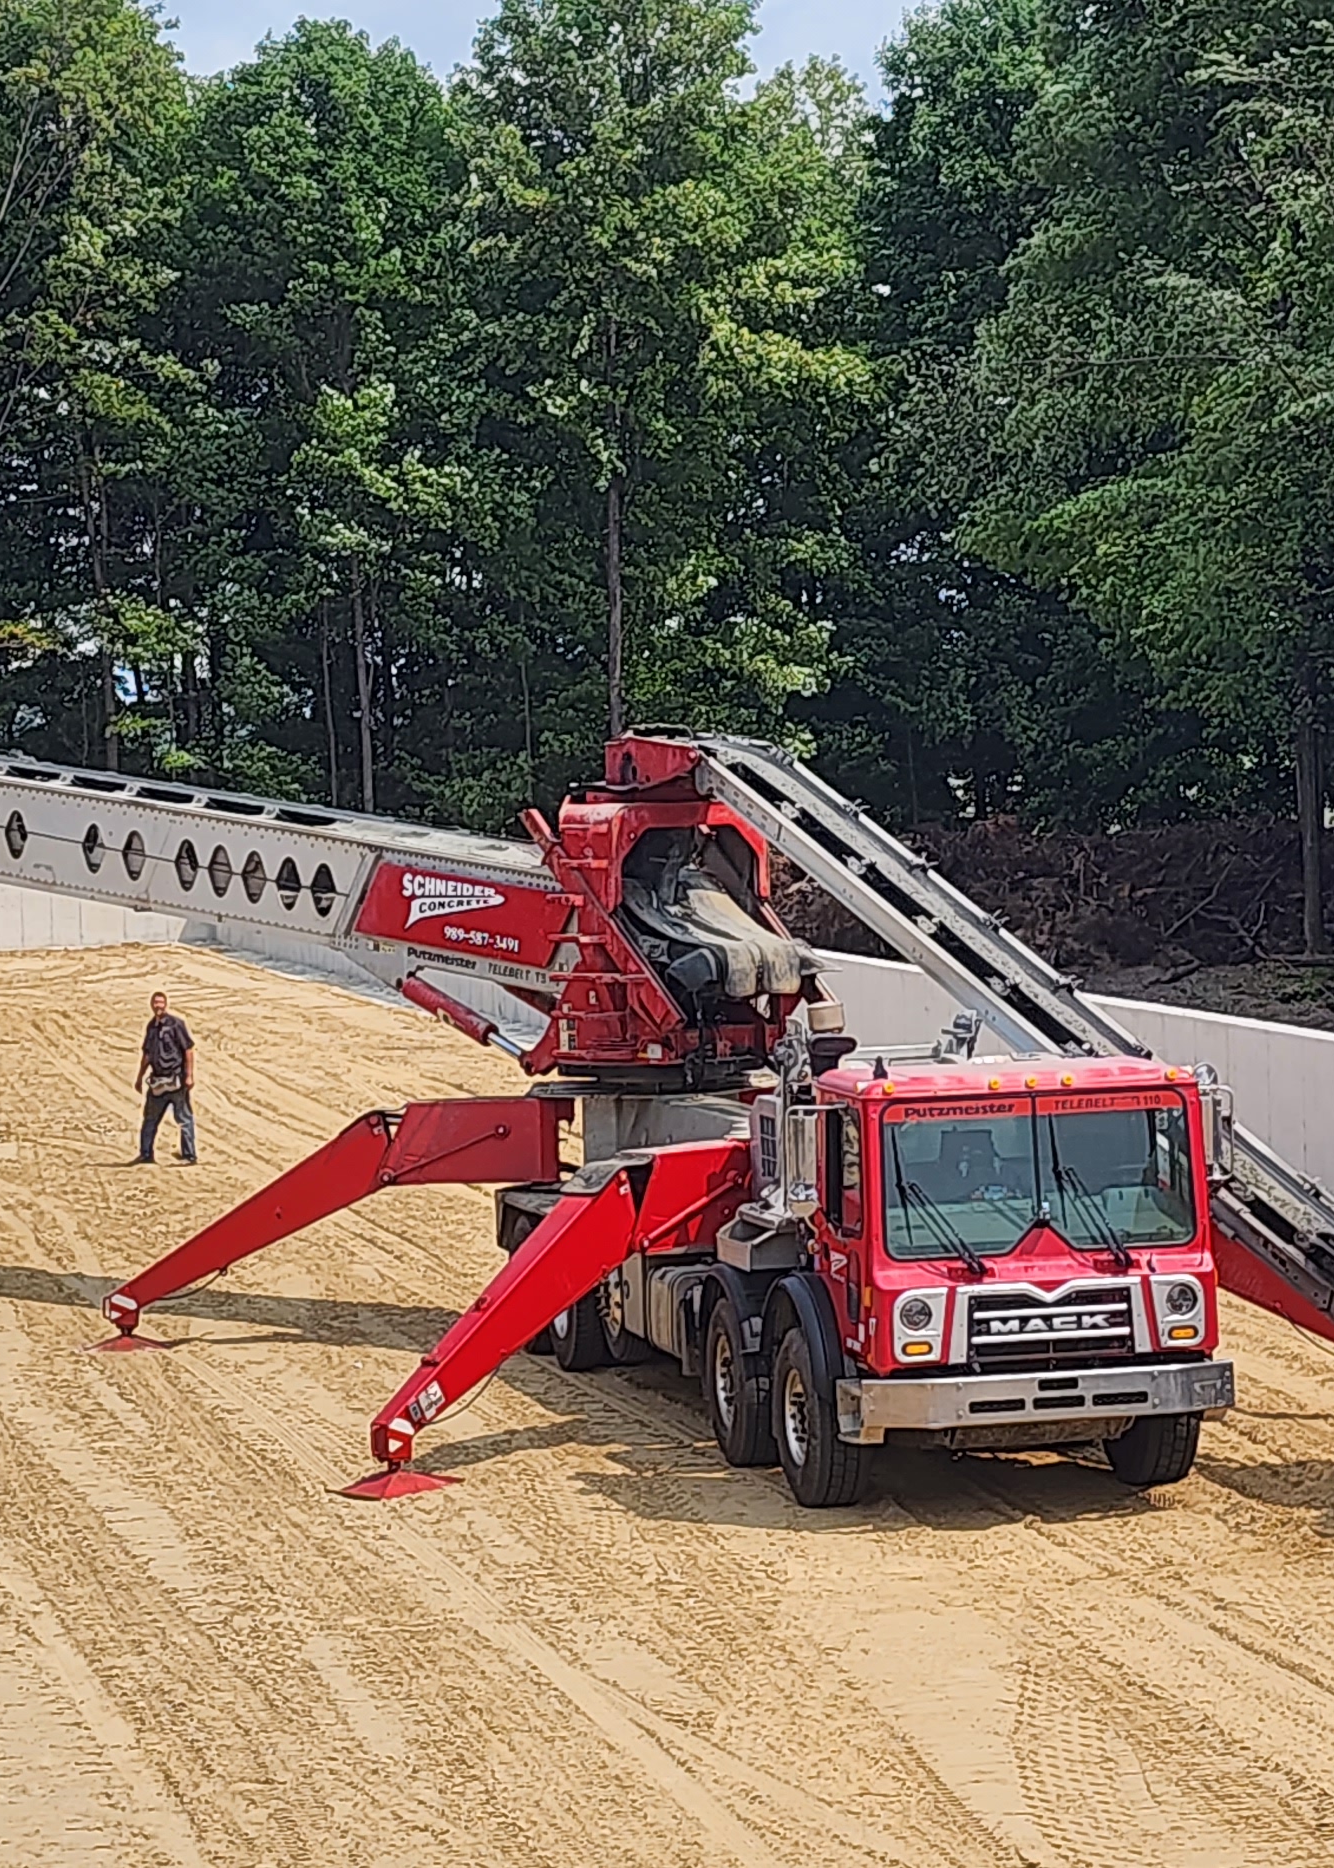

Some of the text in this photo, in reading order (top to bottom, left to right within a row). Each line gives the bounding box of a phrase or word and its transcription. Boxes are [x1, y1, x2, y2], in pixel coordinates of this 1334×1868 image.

[401, 873, 497, 898] SCHNEIDER
[418, 898, 490, 914] CONCRETE
[443, 925, 520, 953] 989-587-3491
[407, 946, 477, 971] Putzmeister
[487, 962, 531, 982] TELEBELT
[903, 1103, 1015, 1118] Putzmeister
[989, 1313, 1111, 1334] MACK
